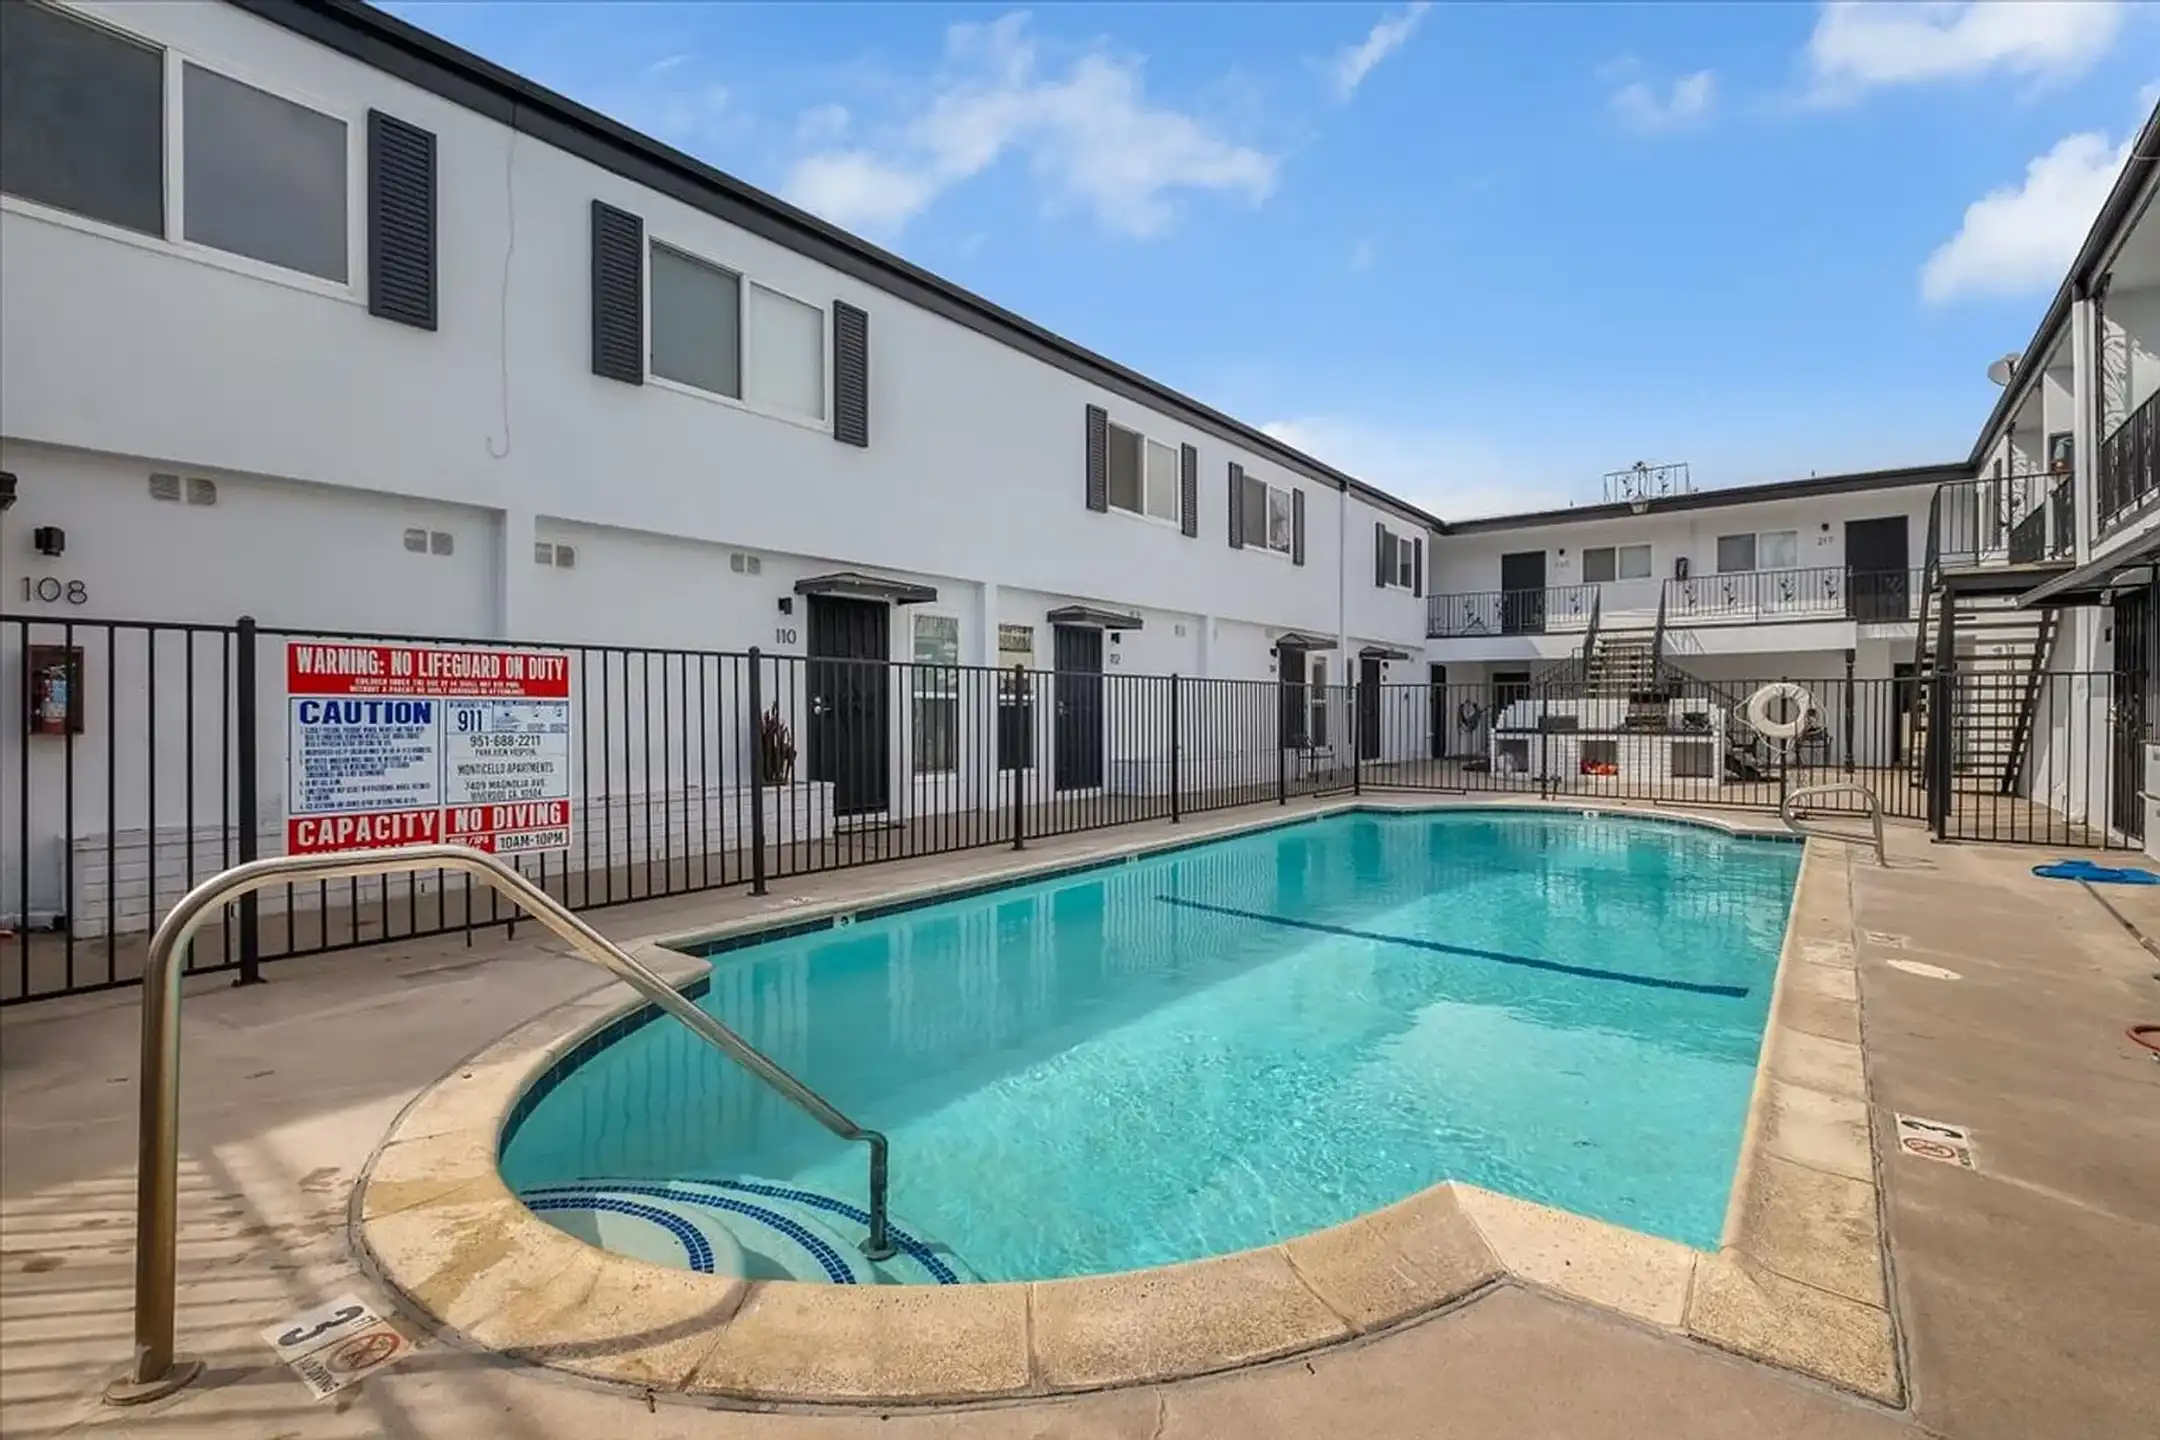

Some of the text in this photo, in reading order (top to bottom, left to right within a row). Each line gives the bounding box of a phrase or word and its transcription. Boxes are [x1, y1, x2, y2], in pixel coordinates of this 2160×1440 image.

[21, 576, 88, 605] 108
[775, 628, 797, 644] 110
[296, 646, 564, 681] WARNING: NO LIFEGUARD ON DUTY
[299, 700, 432, 725] CAUTION
[457, 709, 482, 732] 911
[297, 811, 436, 847] CAPACITY
[455, 802, 561, 833] NO DIVING
[500, 831, 564, 851] 10AM-10PM
[278, 1305, 364, 1346] 3
